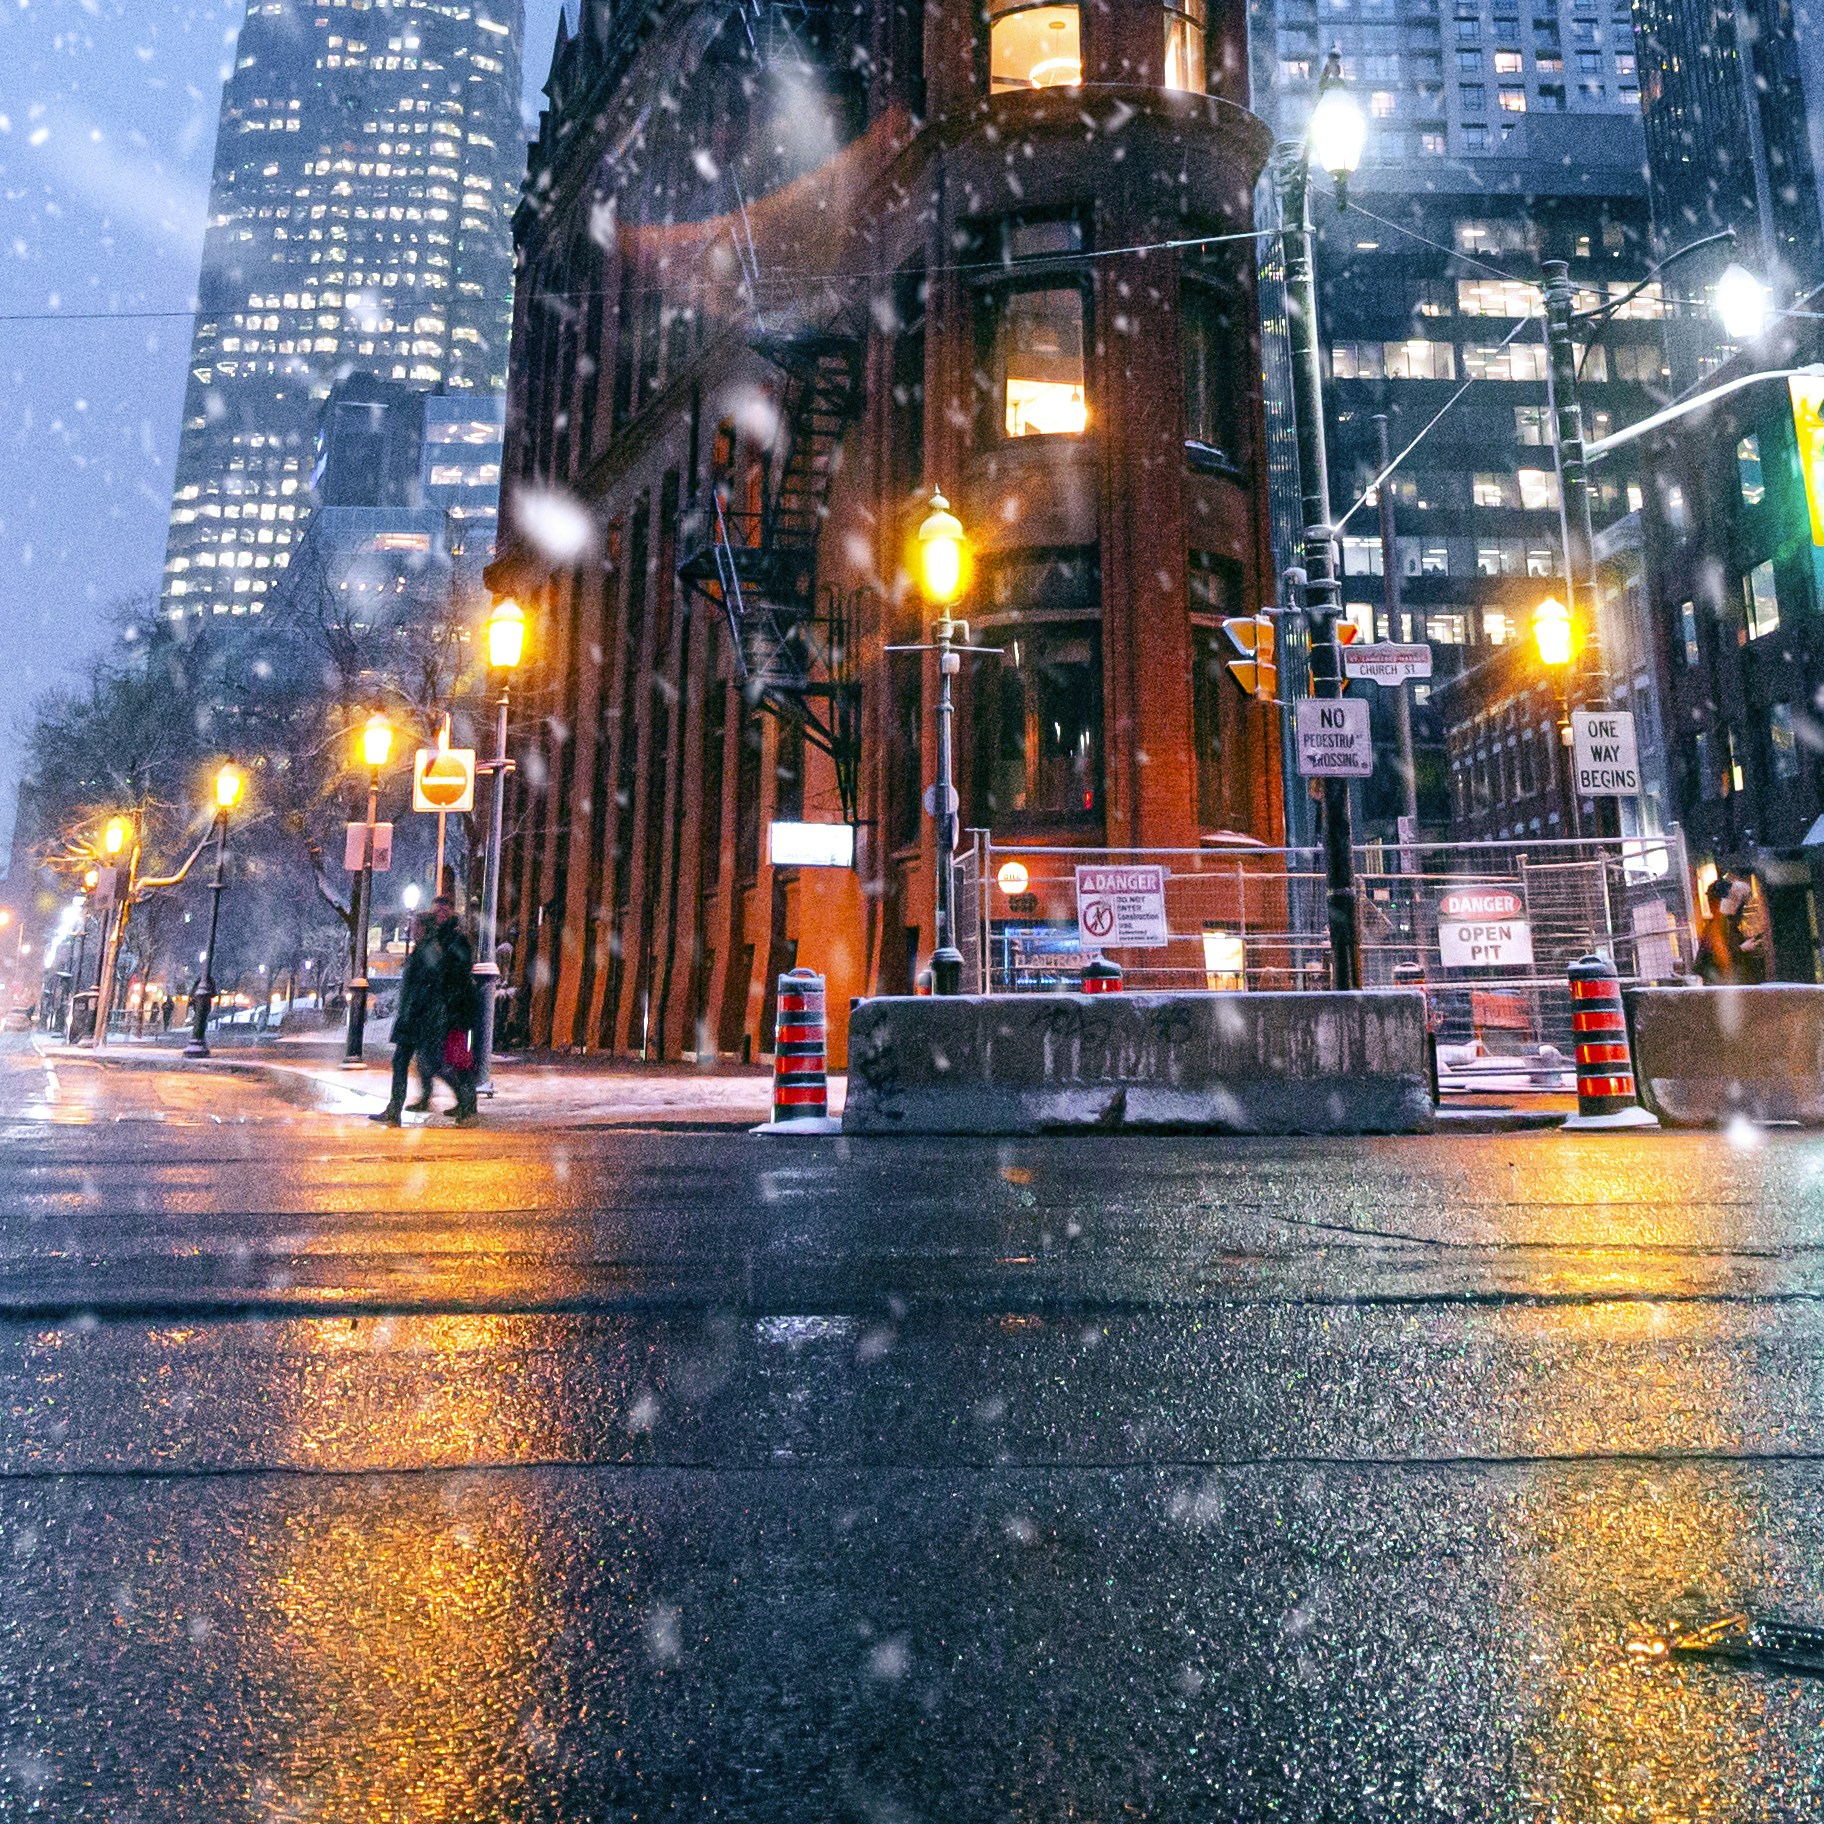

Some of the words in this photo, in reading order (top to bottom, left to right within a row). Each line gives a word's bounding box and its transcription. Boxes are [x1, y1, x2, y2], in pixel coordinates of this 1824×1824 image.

[1359, 664, 1398, 675] CHURCH
[1404, 664, 1416, 675] ST
[1320, 707, 1345, 729] NO
[1588, 720, 1619, 738] ONE
[1590, 745, 1620, 763] WAY
[1580, 770, 1637, 789] BEGINS
[1095, 874, 1158, 892] DANGER
[1448, 895, 1515, 913] DANGER
[1458, 925, 1512, 942] OPEN
[1471, 945, 1502, 960] PIT
